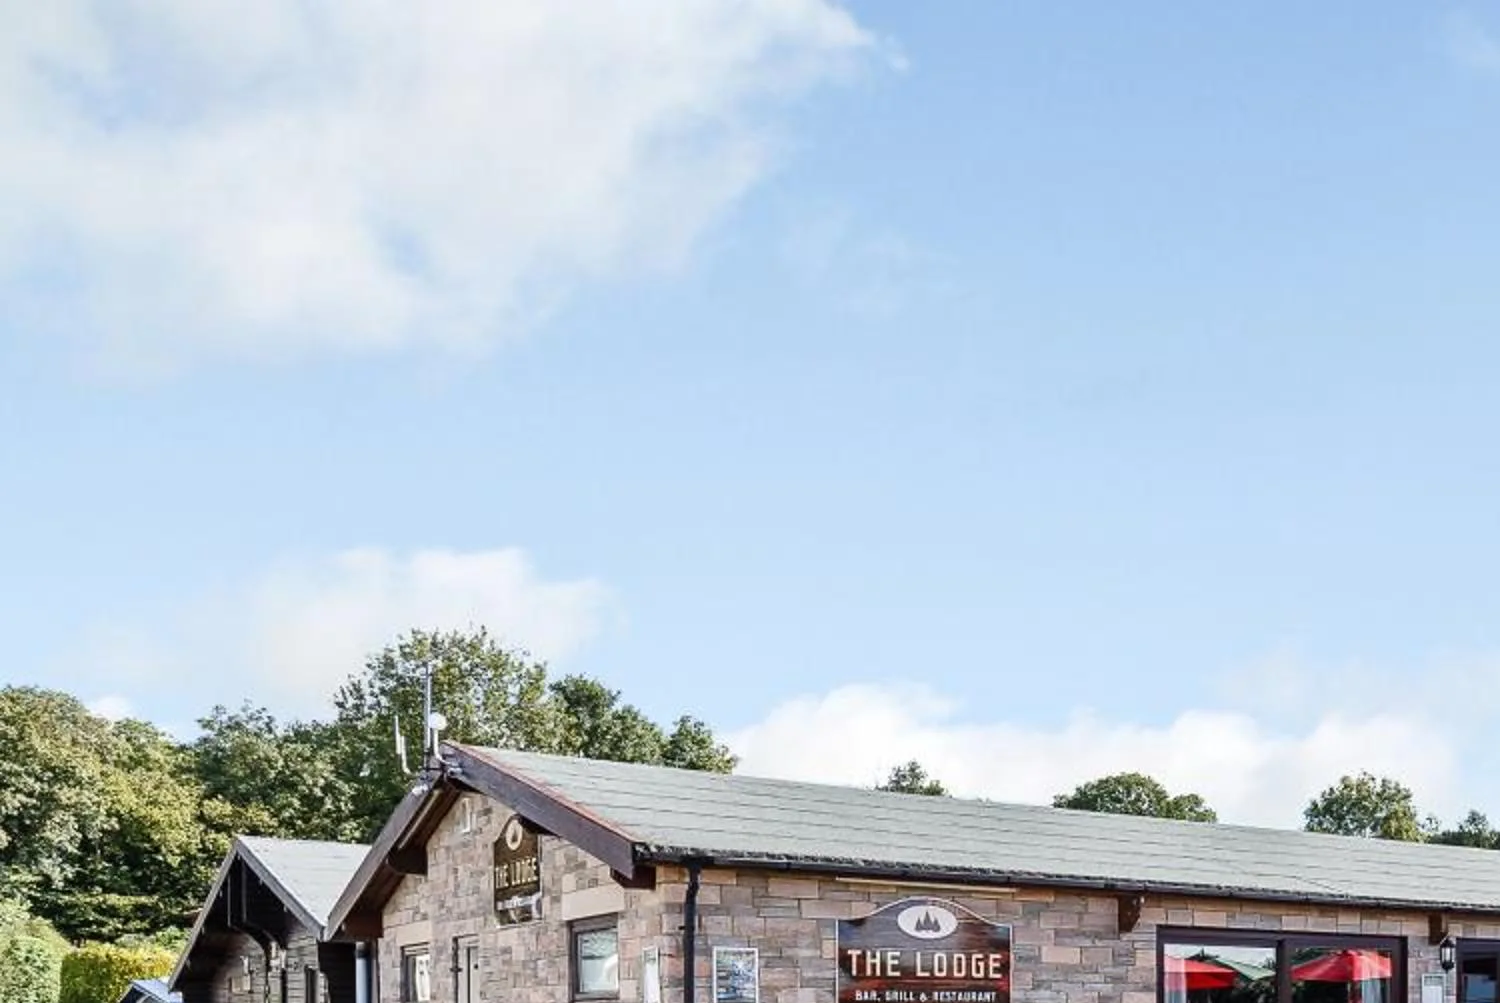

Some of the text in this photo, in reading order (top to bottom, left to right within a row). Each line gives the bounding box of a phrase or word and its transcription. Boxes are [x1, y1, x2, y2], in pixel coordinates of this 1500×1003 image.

[848, 950, 1003, 979] THE LODGE
[885, 989, 915, 1003] GRILL
[919, 990, 928, 1003] &
[932, 990, 997, 1003] RESTAURANT
